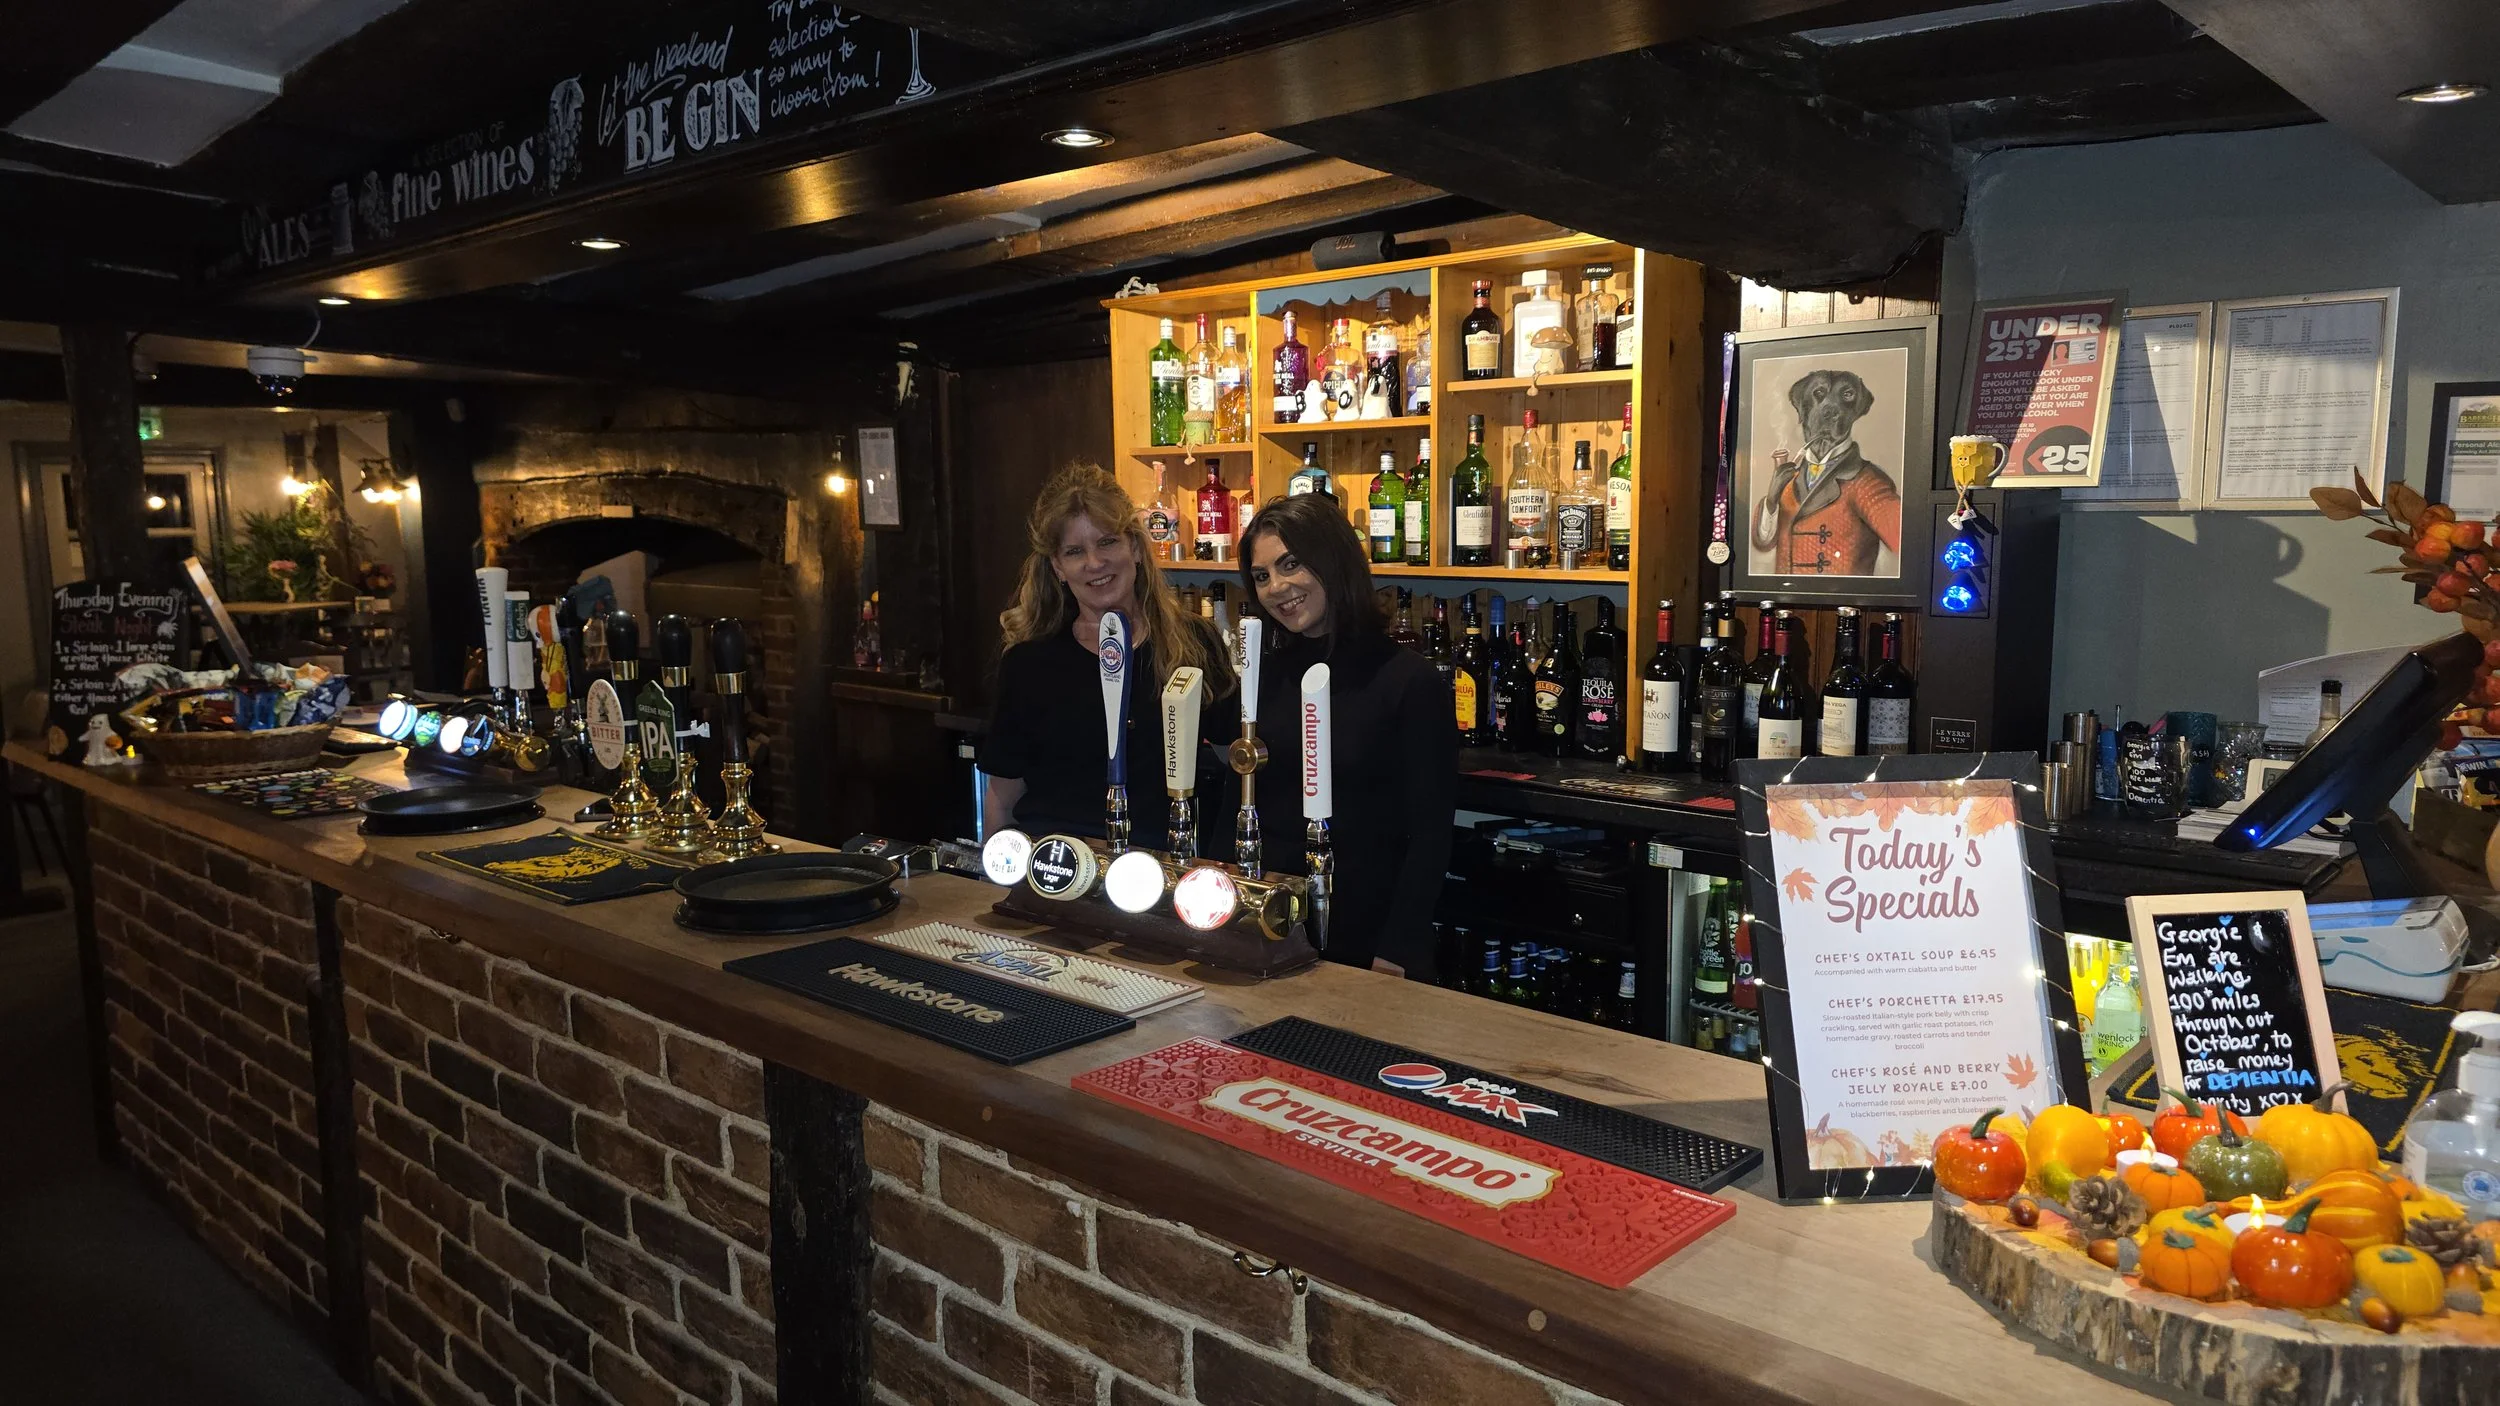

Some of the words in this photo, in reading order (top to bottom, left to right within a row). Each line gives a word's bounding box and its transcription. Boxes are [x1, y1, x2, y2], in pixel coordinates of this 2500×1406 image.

[623, 61, 652, 103] the
[653, 25, 734, 78] weekend
[768, 68, 785, 87] so
[790, 48, 832, 79] many
[838, 36, 858, 64] to
[624, 97, 676, 174] BE
[683, 66, 764, 151] GIN
[392, 170, 442, 223] fine
[452, 135, 536, 206] wines
[258, 212, 310, 269] ALES
[1989, 313, 2103, 341] UNDER
[1984, 338, 2042, 363] 25?
[2032, 369, 2062, 377] LUCKY
[1980, 388, 1990, 396] 25
[2012, 386, 2035, 394] WILL
[2049, 384, 2081, 392] ASKED
[1981, 380, 2020, 388] ENOUGH
[2035, 377, 2060, 385] LOOK
[1993, 395, 2023, 403] PROVE
[2024, 393, 2047, 401] THAT
[2014, 402, 2028, 410] OR
[2055, 400, 2085, 408] WHEN
[2016, 409, 2060, 418] ALCOHOL
[2042, 444, 2090, 473] 25
[1510, 495, 1545, 504] SOUTHERN
[1511, 505, 1542, 514] COMFORT
[54, 584, 115, 617] Thursday
[118, 582, 174, 617] Evening
[1582, 679, 1614, 688] TEQUILA
[1582, 697, 1614, 705] STRAWBERRY
[591, 726, 621, 741] BITTER
[640, 720, 675, 760] IPA
[1166, 704, 1177, 779] Hawkstone
[1940, 735, 1951, 743] DE
[1952, 736, 1966, 744] VIN
[1946, 729, 1971, 738] VERRE
[1303, 702, 1321, 797] Cruzcampo
[1828, 824, 1983, 885] Today's
[1033, 859, 1074, 877] Hawkstone
[1043, 872, 1060, 883] Lager
[1824, 873, 1980, 934] Specials
[2157, 921, 2243, 952] Georgie
[1815, 952, 1860, 964] CHEF'S
[1866, 951, 1916, 962] OXTAIL
[1921, 950, 1954, 960] SOUP
[1960, 948, 1997, 959] £6.95
[2162, 945, 2196, 968] Em
[2207, 949, 2241, 967] are
[1814, 967, 1865, 977] Accompanied
[1907, 965, 1938, 973] ciabatta
[1954, 964, 1977, 972] butter
[828, 961, 1004, 1024] Hawkstone
[1828, 997, 1873, 1009] CHEF'S
[1879, 995, 1957, 1007] PORCHETTA
[1963, 993, 2004, 1005] £17.95
[2211, 991, 2261, 1011] miles
[1822, 1013, 1870, 1022] Slow-roasted
[1872, 1011, 1914, 1020] Italian-style
[1916, 1011, 1933, 1019] pork
[1934, 1010, 1952, 1019] belly
[1953, 1009, 1970, 1017] with
[1971, 1009, 1989, 1017] crisp
[2174, 1013, 2244, 1038] through
[2246, 1010, 2275, 1028] out
[1820, 1024, 1857, 1032] crackling,
[1858, 1023, 1882, 1031] served
[1883, 1022, 1900, 1030] with
[1902, 1021, 1922, 1030] garlic
[1944, 1020, 1978, 1029] potatoes,
[1980, 1019, 1993, 1027] rich
[1826, 1034, 1869, 1042] homemade
[1870, 1034, 1893, 1042] gravy,
[2097, 1031, 2135, 1043] wenlock
[2097, 1037, 2125, 1049] SPRING
[2270, 1029, 2293, 1049] to
[1895, 1043, 1925, 1051] broccoli
[1831, 1067, 1877, 1079] CHEF'S
[1882, 1062, 1917, 1077] ROSÉ
[1924, 1064, 1951, 1075] AND
[1957, 1062, 2001, 1074] BERRY
[2186, 1057, 2229, 1074] raise
[2238, 1052, 2294, 1072] money
[1848, 1083, 1887, 1095] JELLY
[1893, 1081, 1944, 1093] ROYALE
[1950, 1080, 1988, 1091] £7.00
[2206, 1068, 2316, 1092] DEMENTIA
[1421, 1082, 1559, 1128] MAX
[1845, 1099, 1889, 1108] homemade
[1890, 1098, 1906, 1106] rosé
[1926, 1097, 1942, 1106] jelly
[1943, 1096, 1960, 1104] with
[1961, 1094, 2008, 1103] strawberries,
[1850, 1110, 1898, 1119] blackberries,
[1899, 1108, 1941, 1117] raspberries
[1239, 1087, 1532, 1191] Cruzcampo
[1294, 1131, 1382, 1168] SEVILLA
